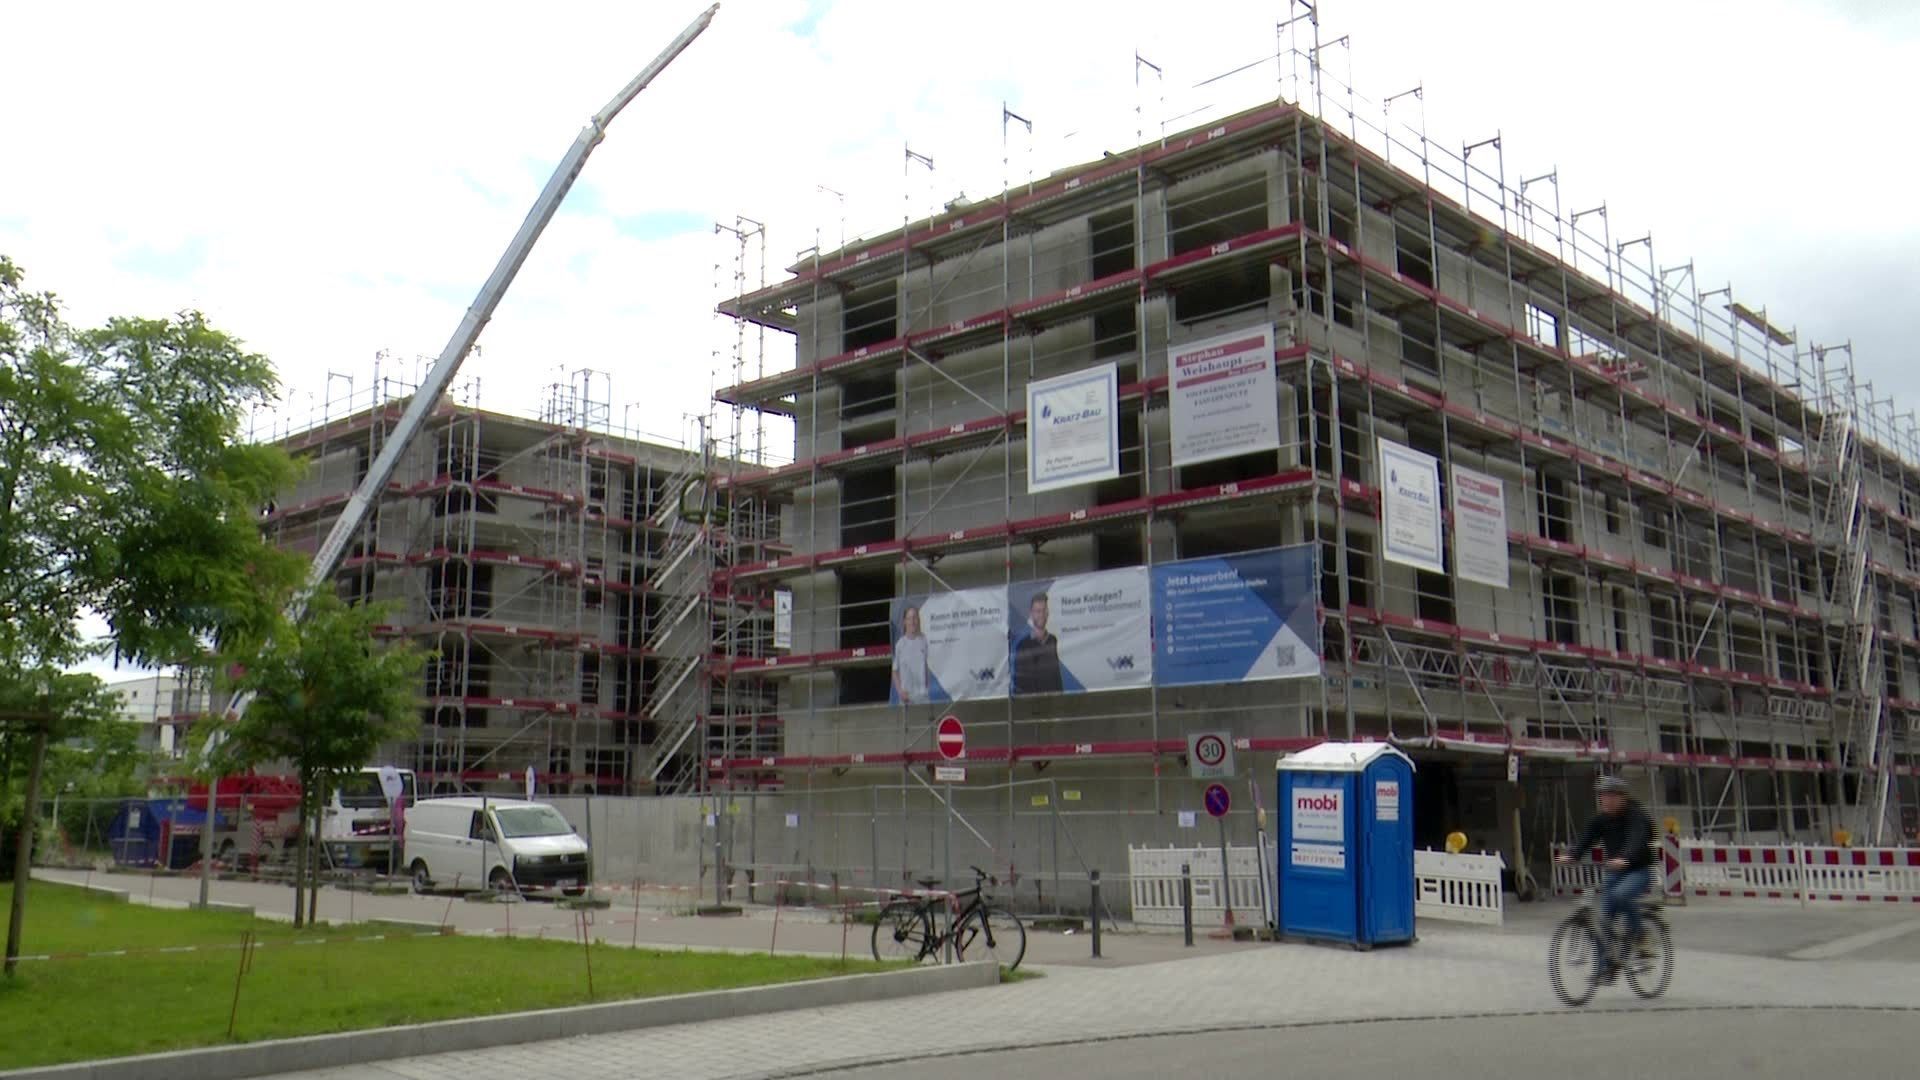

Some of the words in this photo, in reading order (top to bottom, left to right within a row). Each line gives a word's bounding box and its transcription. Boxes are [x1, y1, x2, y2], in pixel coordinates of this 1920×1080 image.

[1181, 346, 1225, 365] Stephan
[1182, 356, 1243, 377] Weishaupt
[1167, 575, 1188, 586] Jetzt
[1190, 569, 1238, 583] bewerben!
[1061, 596, 1081, 605] Neue
[1083, 589, 1122, 604] Kollegen?
[980, 606, 1000, 616] Team
[1202, 743, 1220, 757] 30
[1376, 786, 1397, 798] mobi
[1297, 794, 1338, 811] mobi
